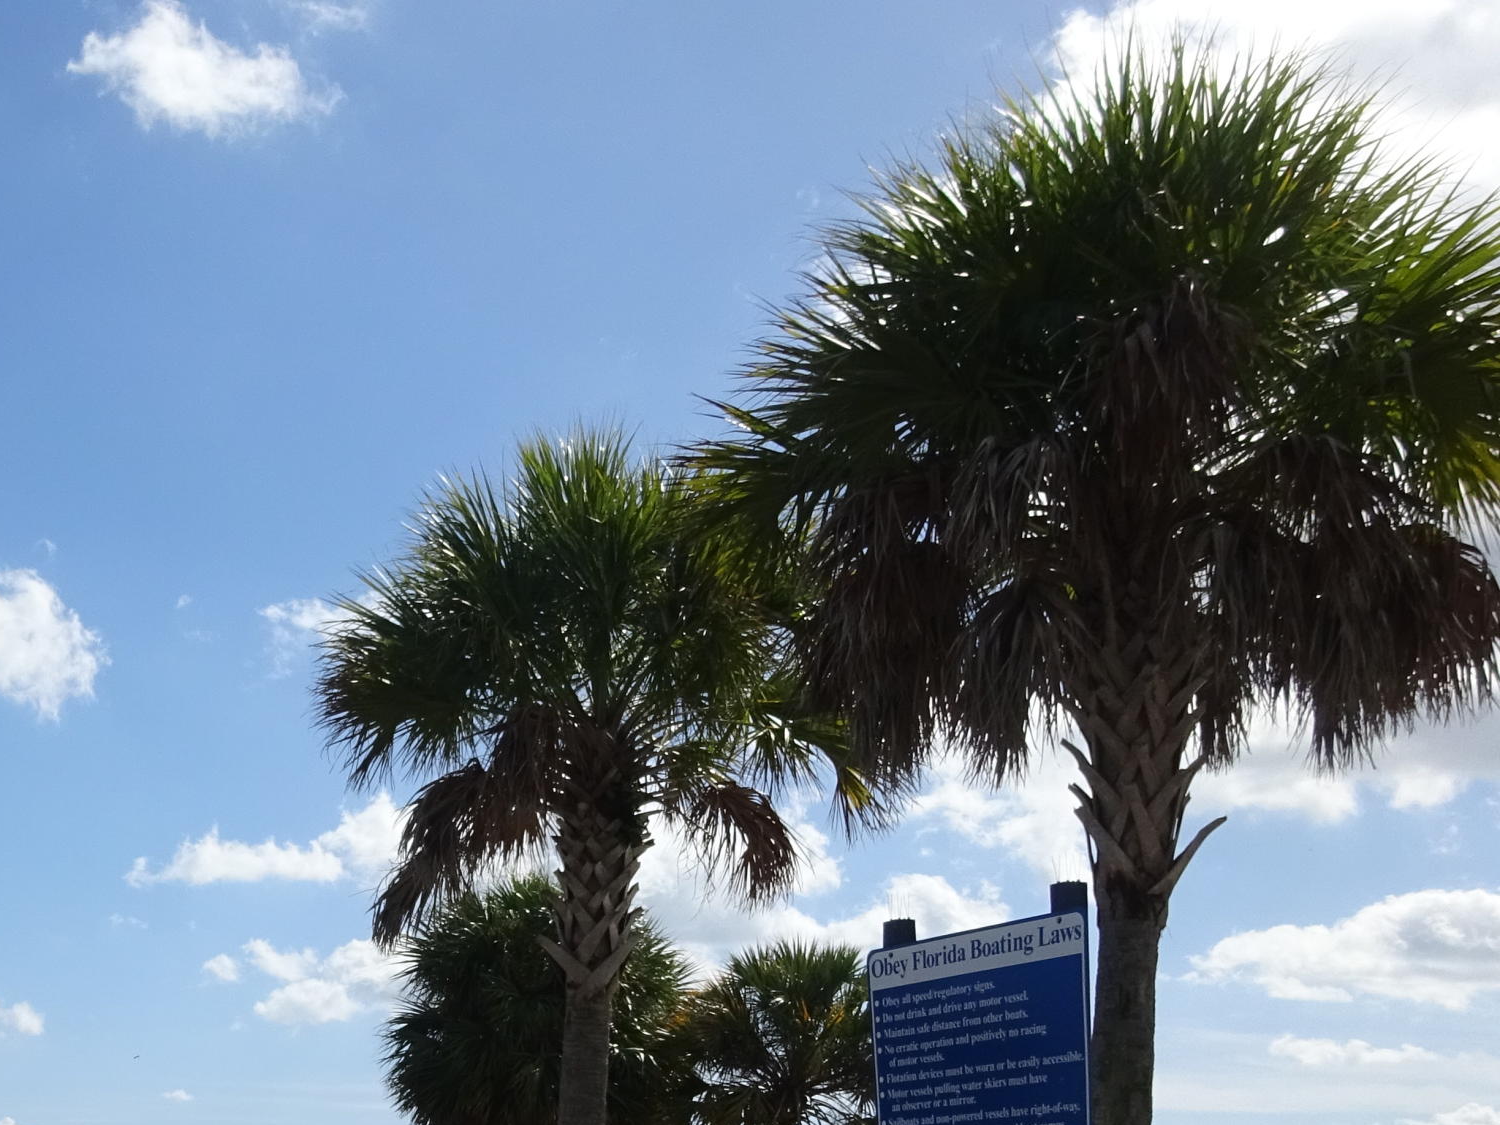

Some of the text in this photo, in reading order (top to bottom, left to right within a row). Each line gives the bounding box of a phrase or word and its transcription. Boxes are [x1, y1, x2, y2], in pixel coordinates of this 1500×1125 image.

[871, 925, 1082, 979] Obey Florida Boating Laws
[882, 981, 996, 1008] Obey all speed/regulatory signs.
[882, 990, 1029, 1023] Do not drink and drive any motor vessel.
[884, 1010, 1029, 1038] Maintain safe distance from other boats.
[884, 1023, 1047, 1054] No erratic operation and positively no racing
[886, 1050, 1084, 1083] Flotation devices must be worn or be easily accessible.
[888, 1051, 945, 1067] of motor vessels.
[887, 1073, 1048, 1098] Motor vessels pulling water skiers must have
[891, 1096, 977, 1112] an observer or a mirror.
[921, 1114, 935, 1125] and
[935, 1110, 983, 1125] non-powered
[985, 1107, 1010, 1119] vessels
[1011, 1106, 1029, 1117] have
[1030, 1102, 1081, 1118] right-of-way.
